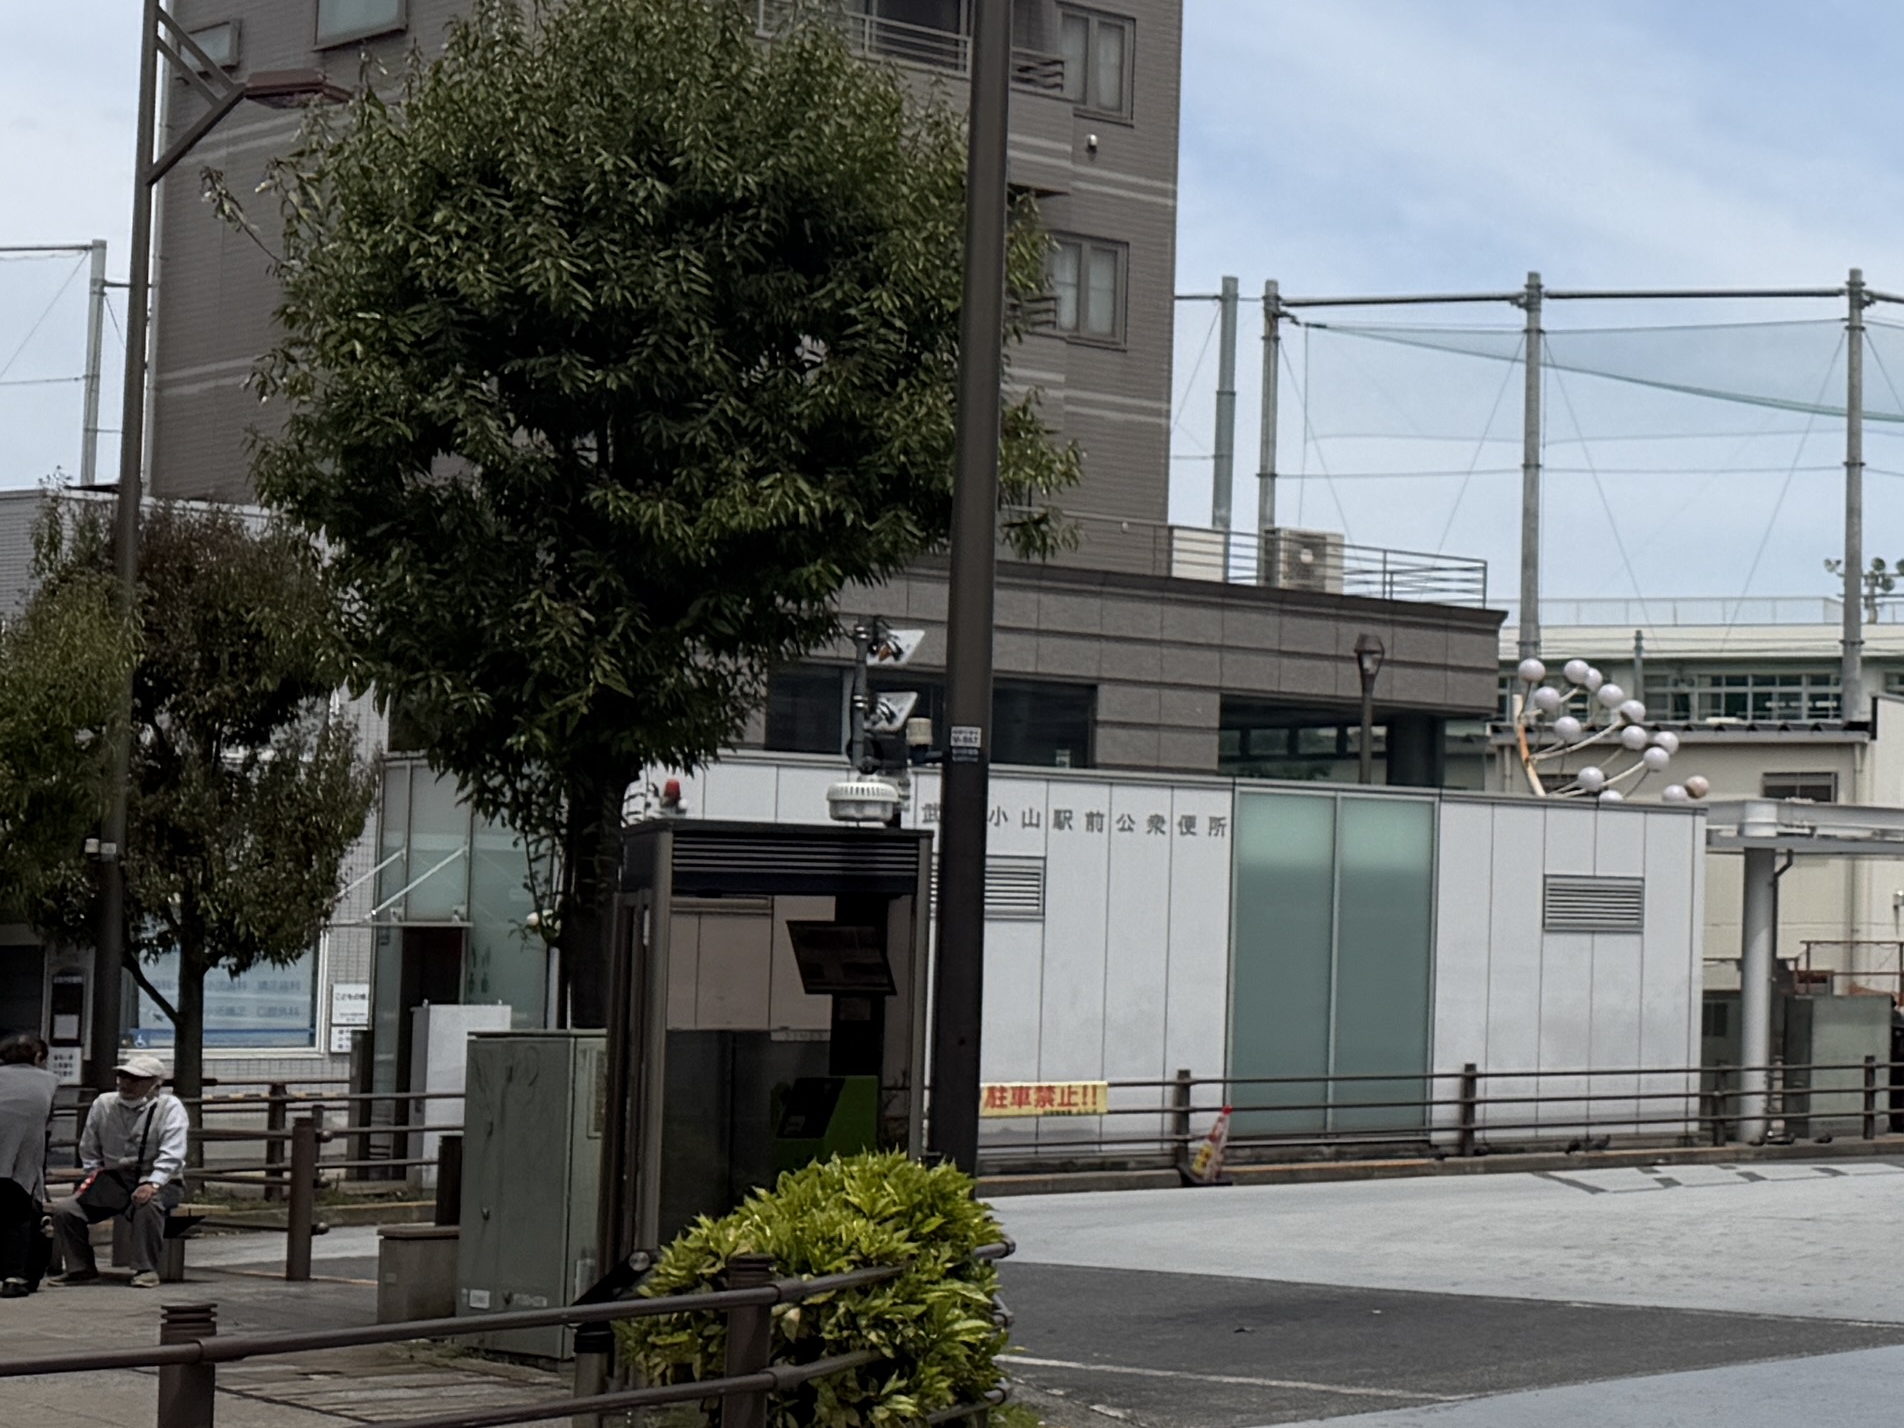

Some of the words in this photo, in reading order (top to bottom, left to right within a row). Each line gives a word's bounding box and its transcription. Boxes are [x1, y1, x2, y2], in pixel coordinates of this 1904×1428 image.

[921, 802, 1227, 838] 武小山駅前公衆便所
